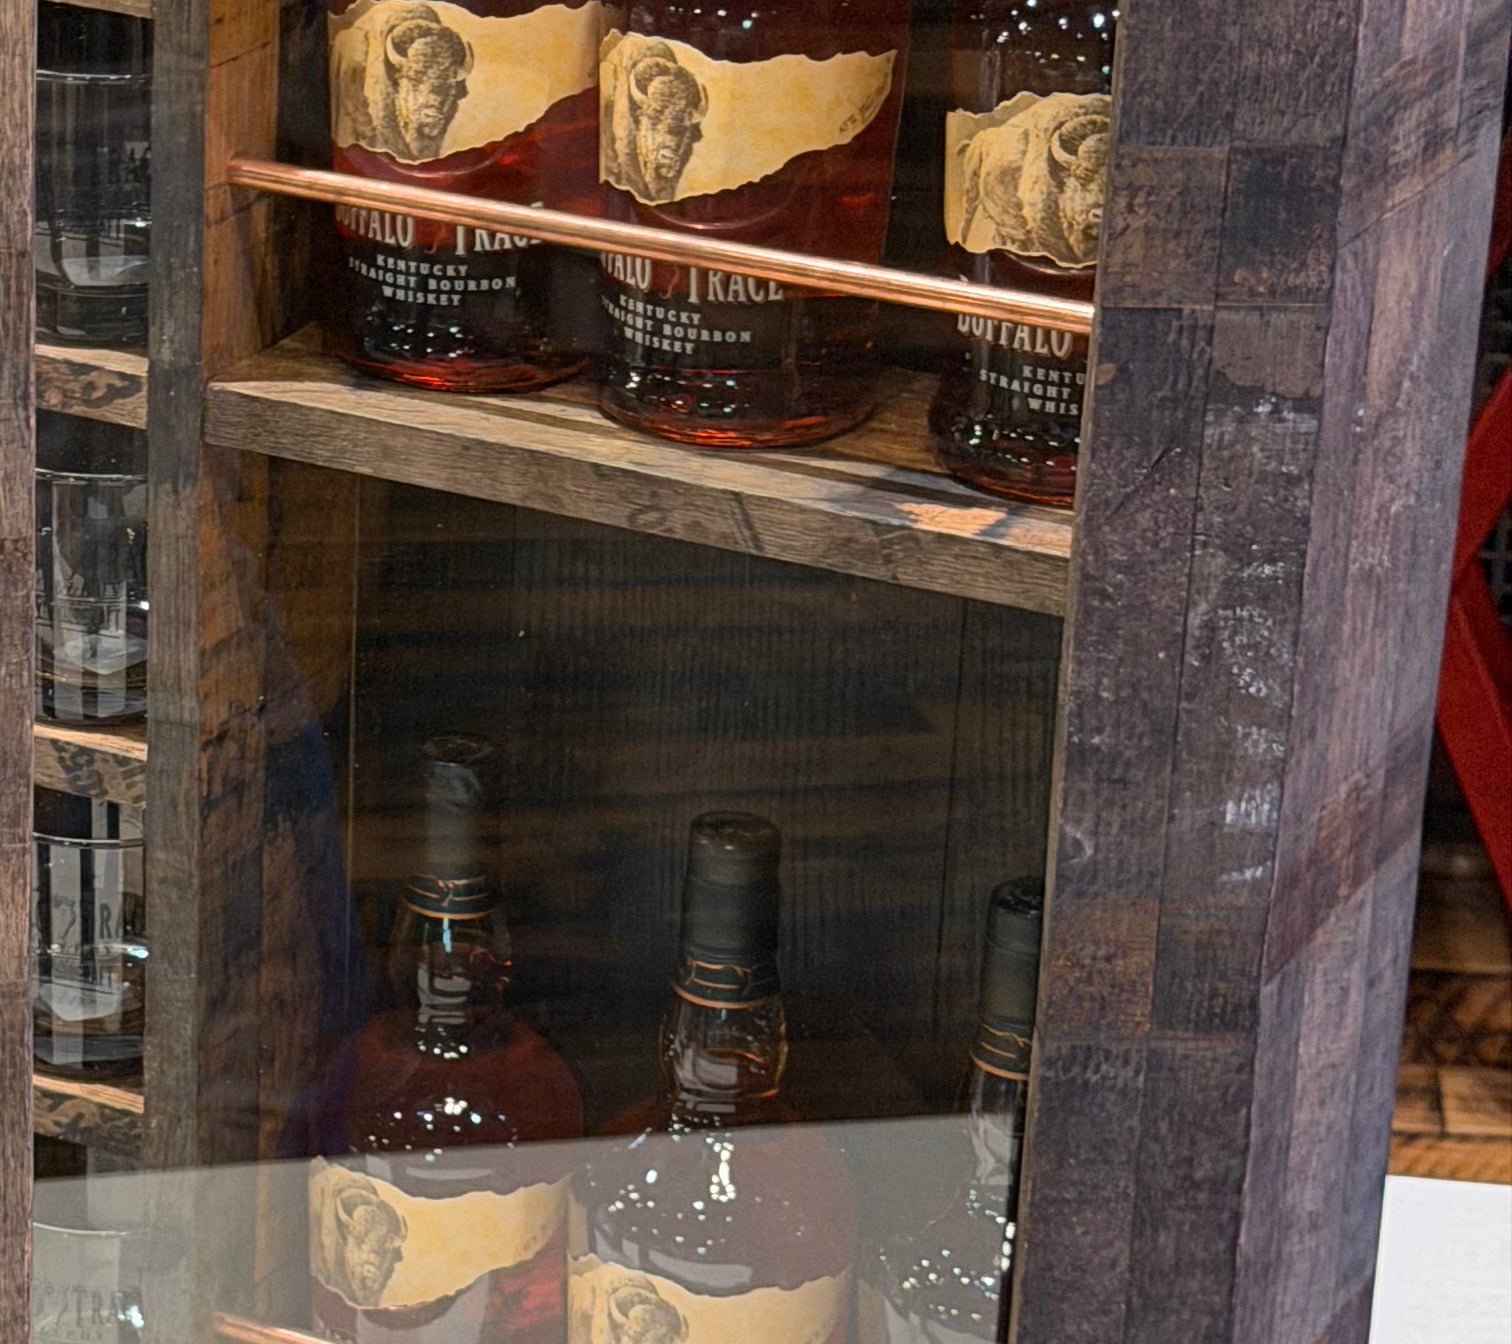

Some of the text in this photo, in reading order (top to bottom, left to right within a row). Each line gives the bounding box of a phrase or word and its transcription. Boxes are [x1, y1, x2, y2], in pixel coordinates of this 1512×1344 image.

[349, 256, 516, 291] STRAIGHT BOURBON
[377, 254, 468, 276] KENTUCKY
[382, 285, 462, 306] WHISKEY
[619, 294, 702, 325] KENTUCKY
[623, 326, 695, 355] WHISKEY
[662, 323, 752, 343] BOURBON
[979, 369, 1071, 399] STRAIGHT
[1022, 365, 1086, 385] KENTU
[1028, 397, 1079, 415] WHIS
